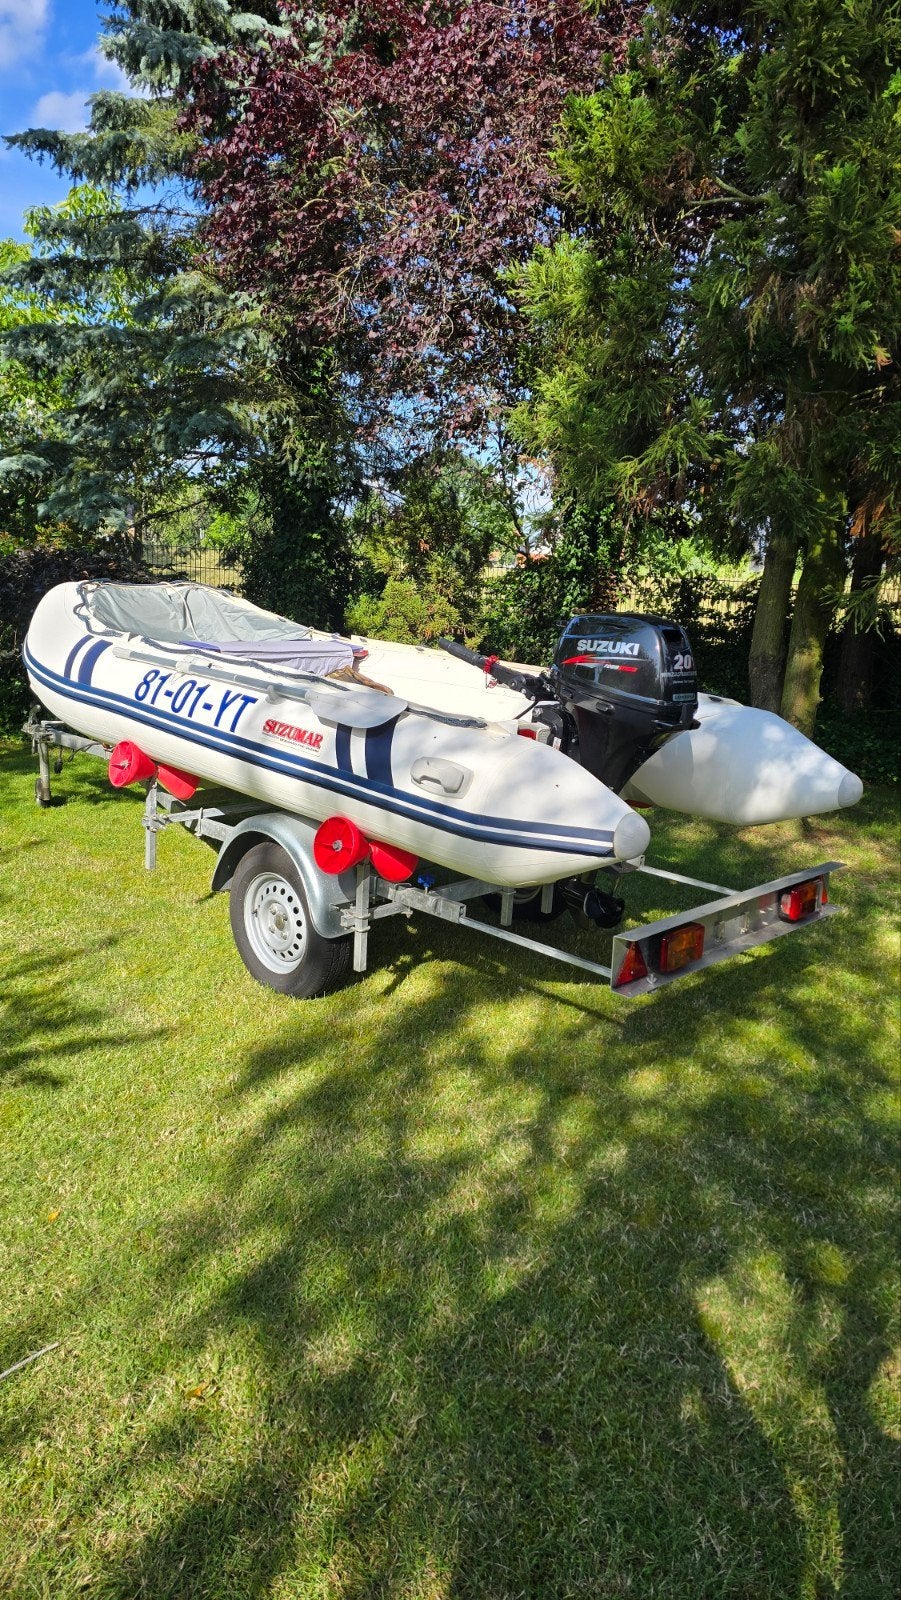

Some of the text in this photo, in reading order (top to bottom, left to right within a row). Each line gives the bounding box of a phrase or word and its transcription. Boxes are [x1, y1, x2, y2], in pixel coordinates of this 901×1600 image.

[577, 640, 640, 655] SUZUKI
[673, 654, 692, 670] 20
[134, 669, 259, 733] 81-01-YT
[263, 719, 323, 750] SUZUMAR
